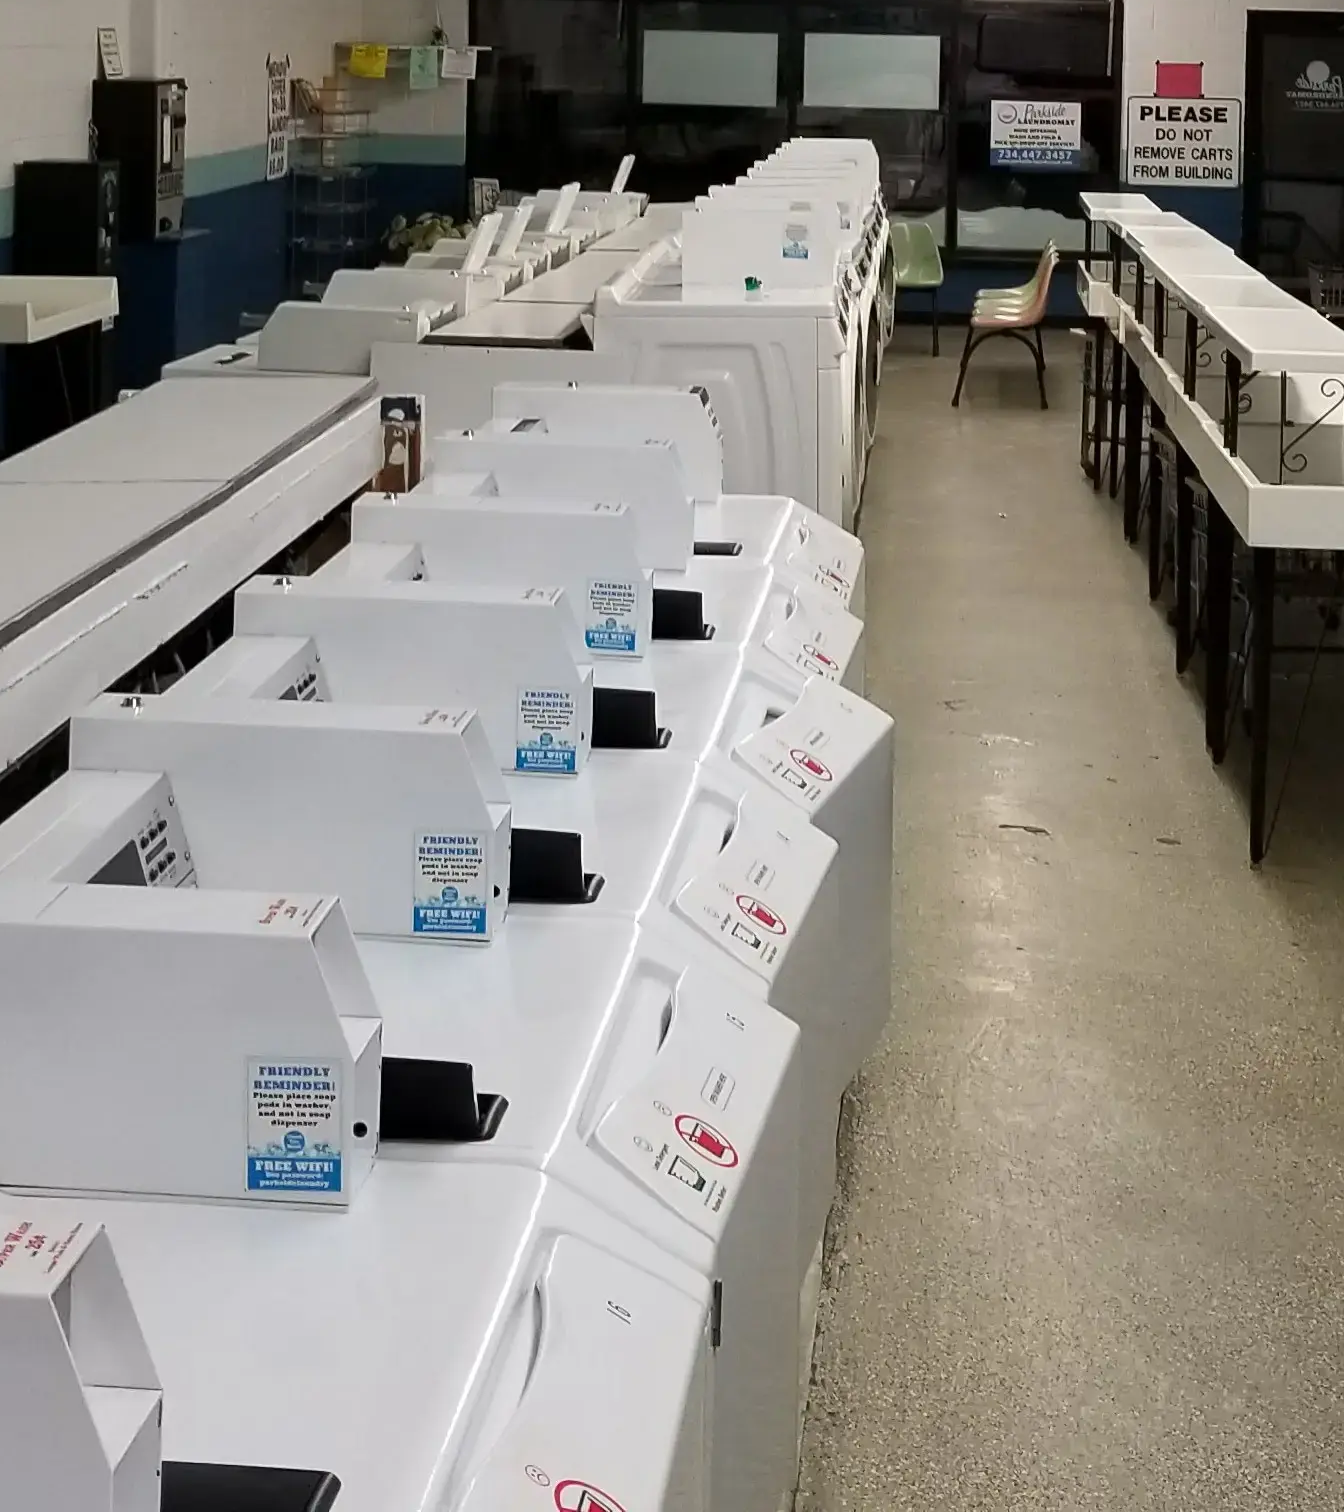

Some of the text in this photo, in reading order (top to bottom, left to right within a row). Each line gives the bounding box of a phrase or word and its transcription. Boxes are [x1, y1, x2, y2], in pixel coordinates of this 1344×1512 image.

[1140, 105, 1228, 123] PLEASE
[1155, 128, 1213, 142] DO NOT
[1134, 146, 1233, 161] REMOVE CARTS
[1133, 165, 1233, 180] FROM BUILDING
[423, 836, 478, 845] FRIENDLY
[418, 847, 483, 856] REMINDER!
[419, 909, 448, 918] FREE
[258, 1066, 331, 1077] FRIENDLY
[253, 1080, 335, 1091] REMINDER!
[314, 1094, 336, 1102] soap
[271, 1119, 318, 1128] dispenser
[255, 1160, 334, 1172] FREE WIFI!
